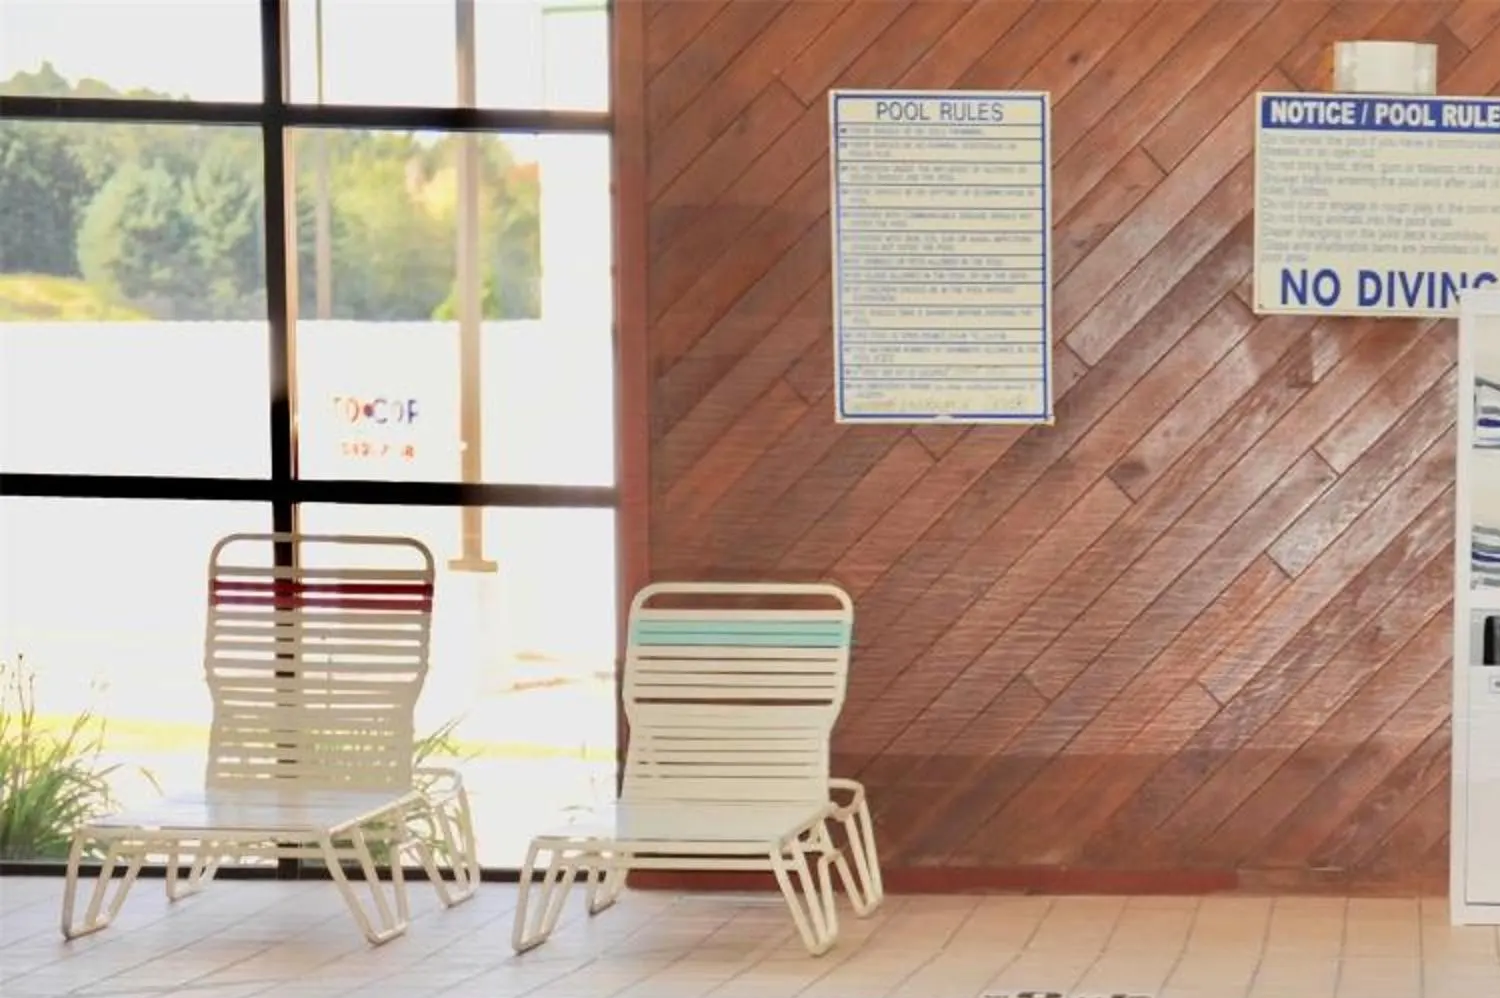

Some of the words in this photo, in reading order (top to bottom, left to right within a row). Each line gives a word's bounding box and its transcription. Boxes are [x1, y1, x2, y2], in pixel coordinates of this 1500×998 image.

[875, 102, 930, 121] POOL
[939, 102, 1005, 122] RULES
[1270, 100, 1356, 125] NOTICE
[1360, 102, 1368, 124] /
[1375, 103, 1436, 127] POOL
[1280, 267, 1341, 307] NO
